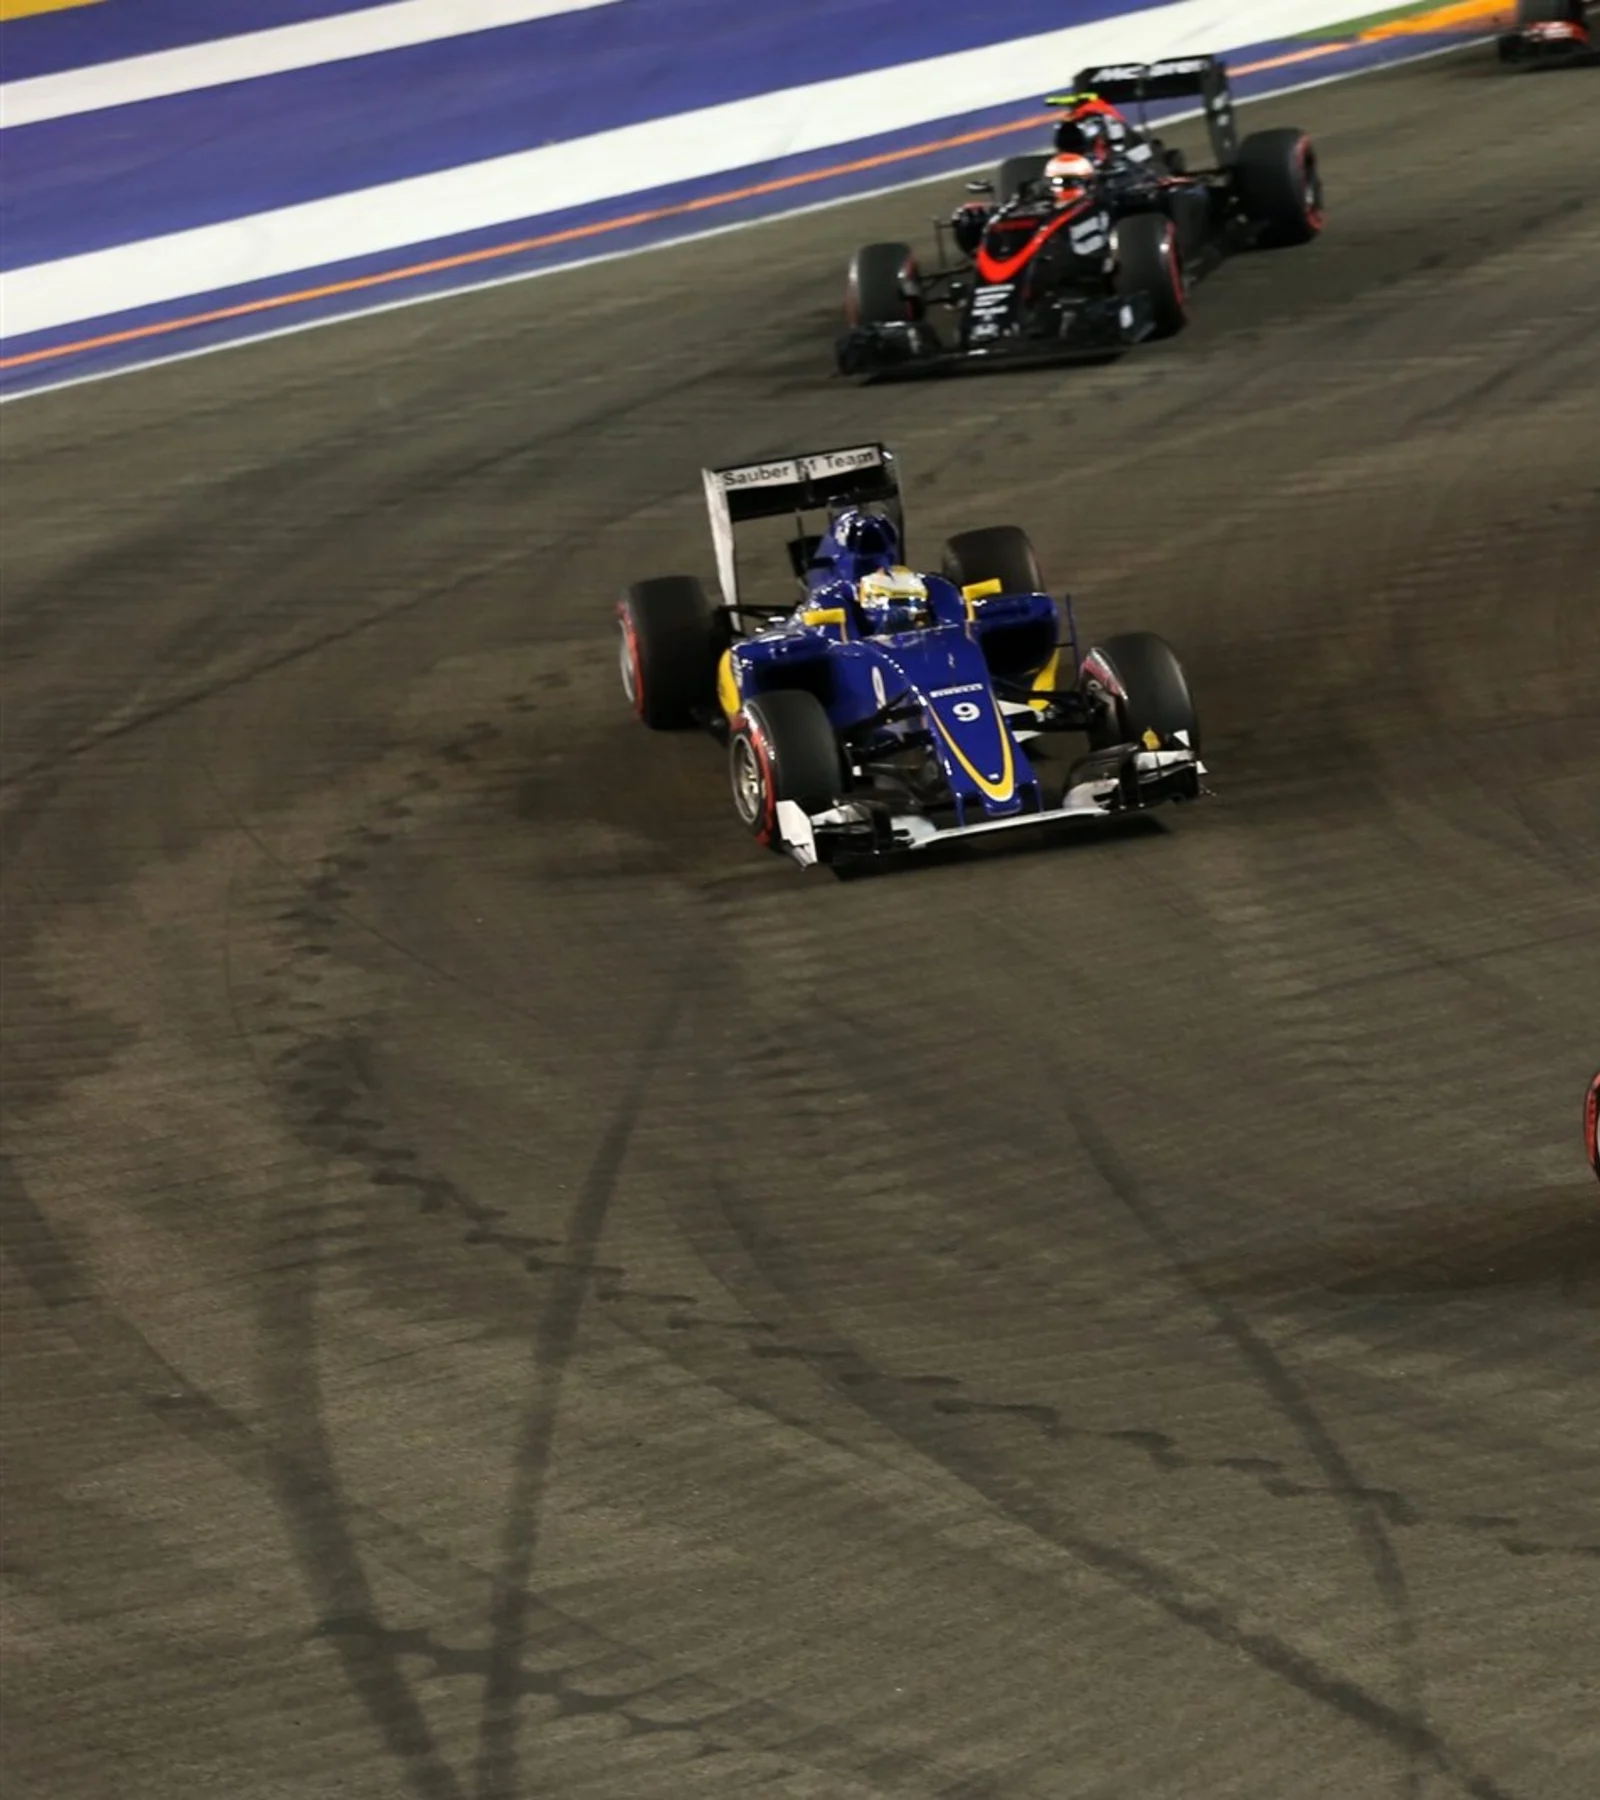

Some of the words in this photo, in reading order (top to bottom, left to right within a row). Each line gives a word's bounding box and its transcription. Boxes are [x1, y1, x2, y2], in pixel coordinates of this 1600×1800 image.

[723, 464, 789, 487] Sauber
[823, 451, 875, 469] Team
[952, 702, 980, 722] 9
